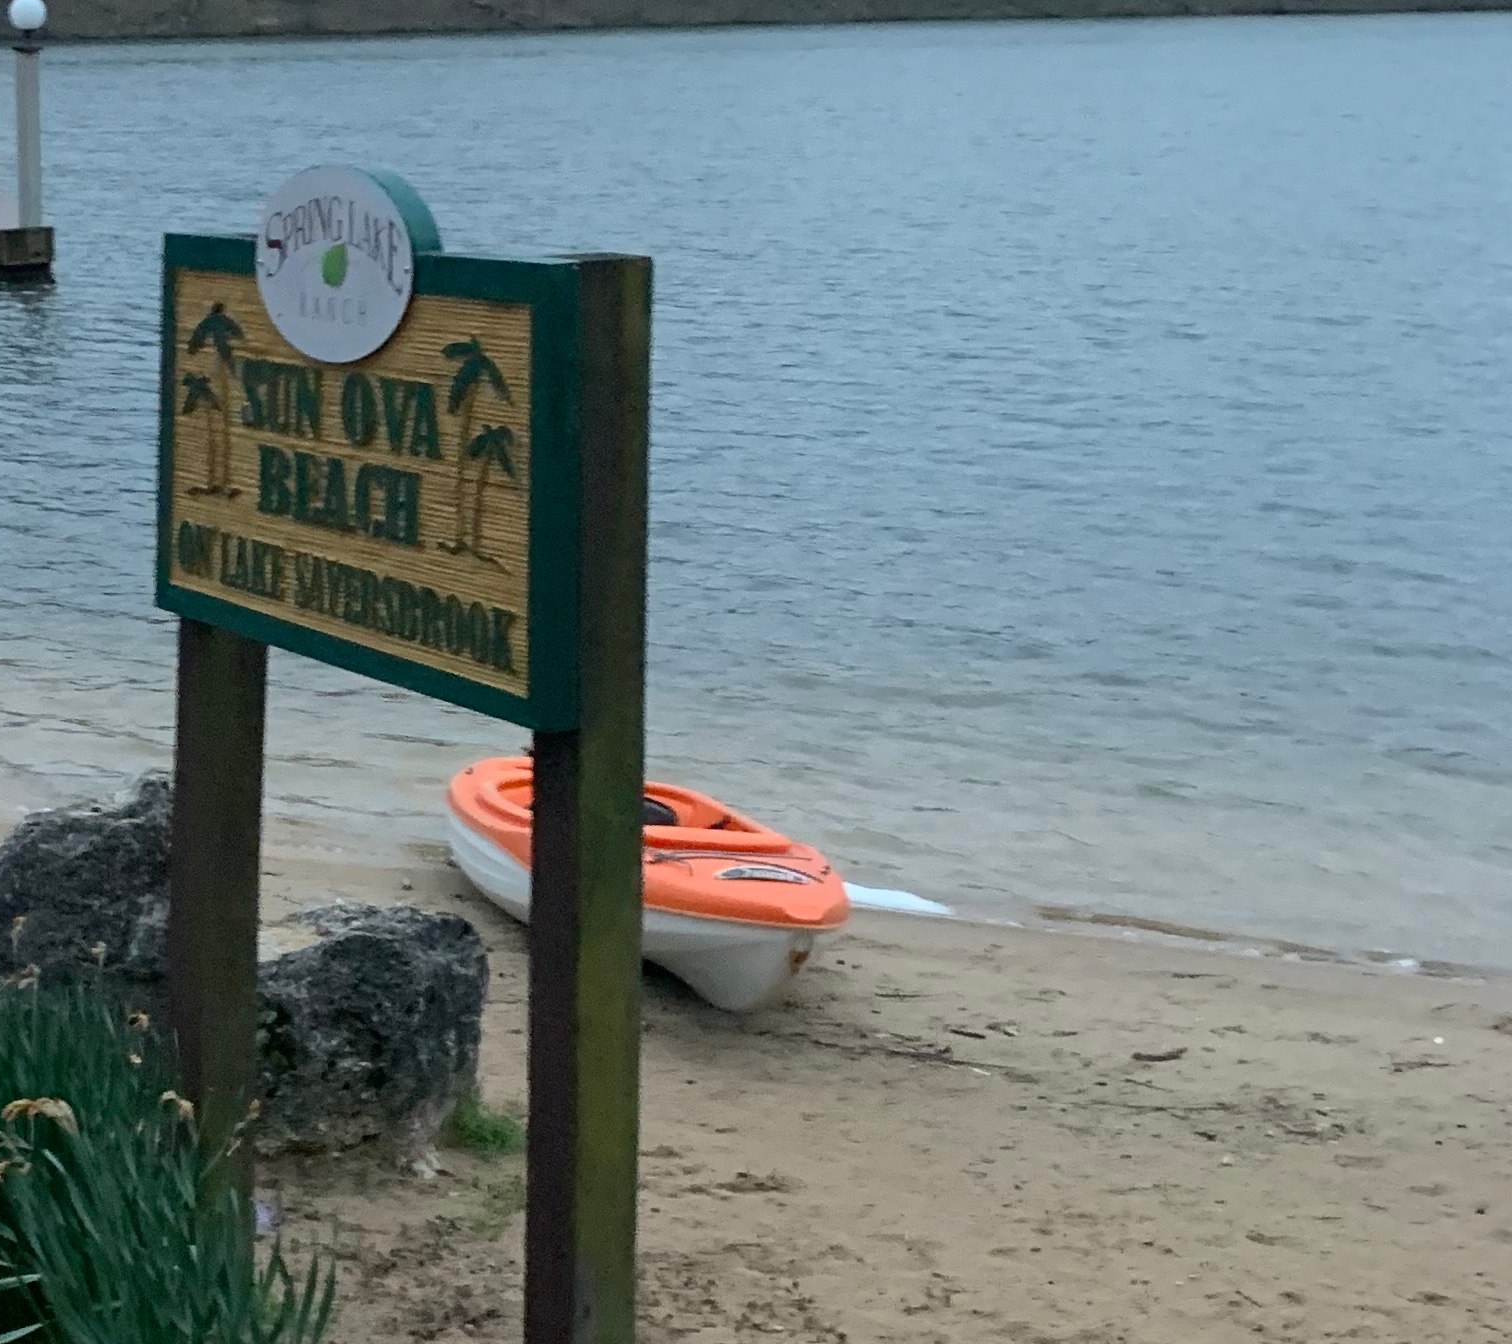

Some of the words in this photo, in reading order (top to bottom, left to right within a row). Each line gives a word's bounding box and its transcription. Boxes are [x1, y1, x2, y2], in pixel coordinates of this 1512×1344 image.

[265, 195, 343, 278] SPRING
[347, 199, 404, 296] LAKE
[241, 358, 322, 441] SUN
[342, 371, 443, 461] OVA
[257, 443, 422, 546] BEACH
[219, 531, 286, 602] LAKE
